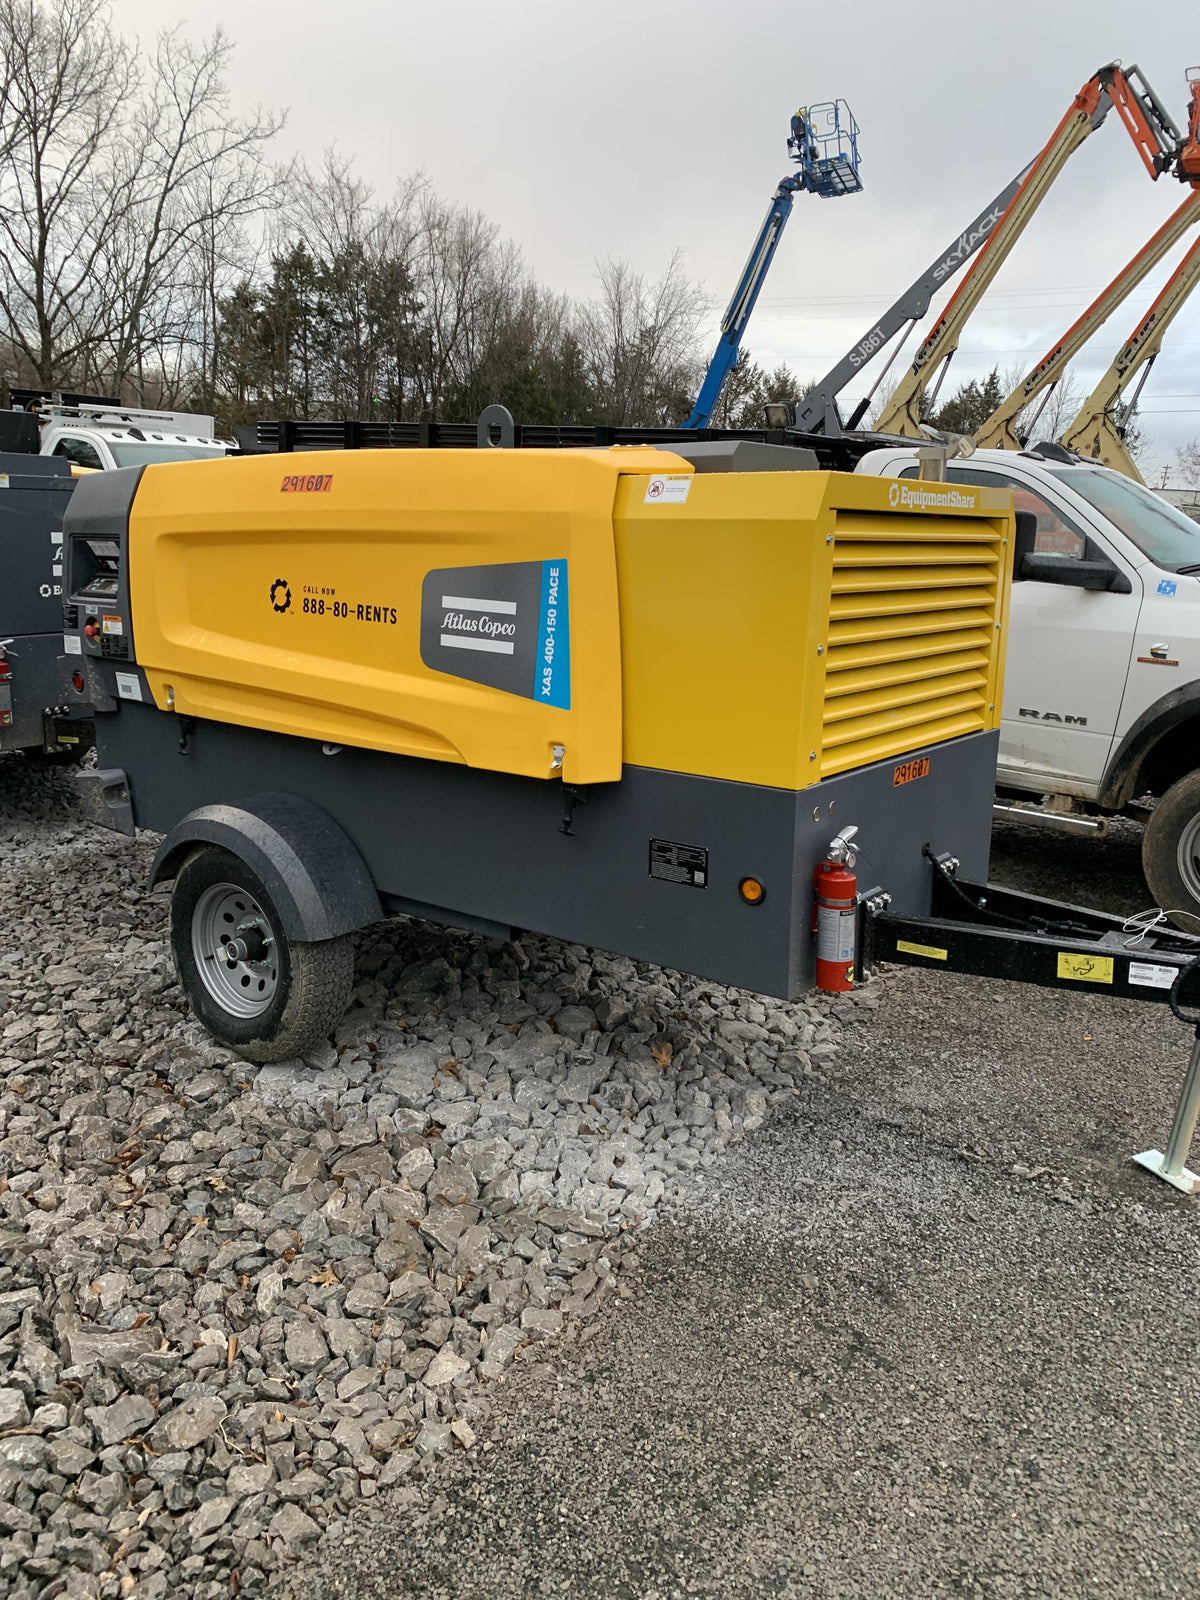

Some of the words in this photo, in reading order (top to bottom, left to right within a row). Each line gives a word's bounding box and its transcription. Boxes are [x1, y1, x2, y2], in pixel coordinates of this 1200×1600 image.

[932, 206, 1005, 281] SKYJACK
[849, 326, 885, 367] SJ86T
[281, 474, 333, 492] 291607
[900, 486, 975, 509] EquipmentShare
[303, 585, 319, 595] CALL
[321, 587, 336, 596] NOW
[548, 567, 560, 606] PACE
[303, 597, 397, 624] 888-80-RENTS
[440, 612, 478, 633] Atlas
[478, 615, 516, 637] Copco
[544, 608, 558, 665] 400-150
[541, 667, 553, 697] XAS
[1018, 707, 1088, 726] RAM
[894, 757, 930, 786] 291607
